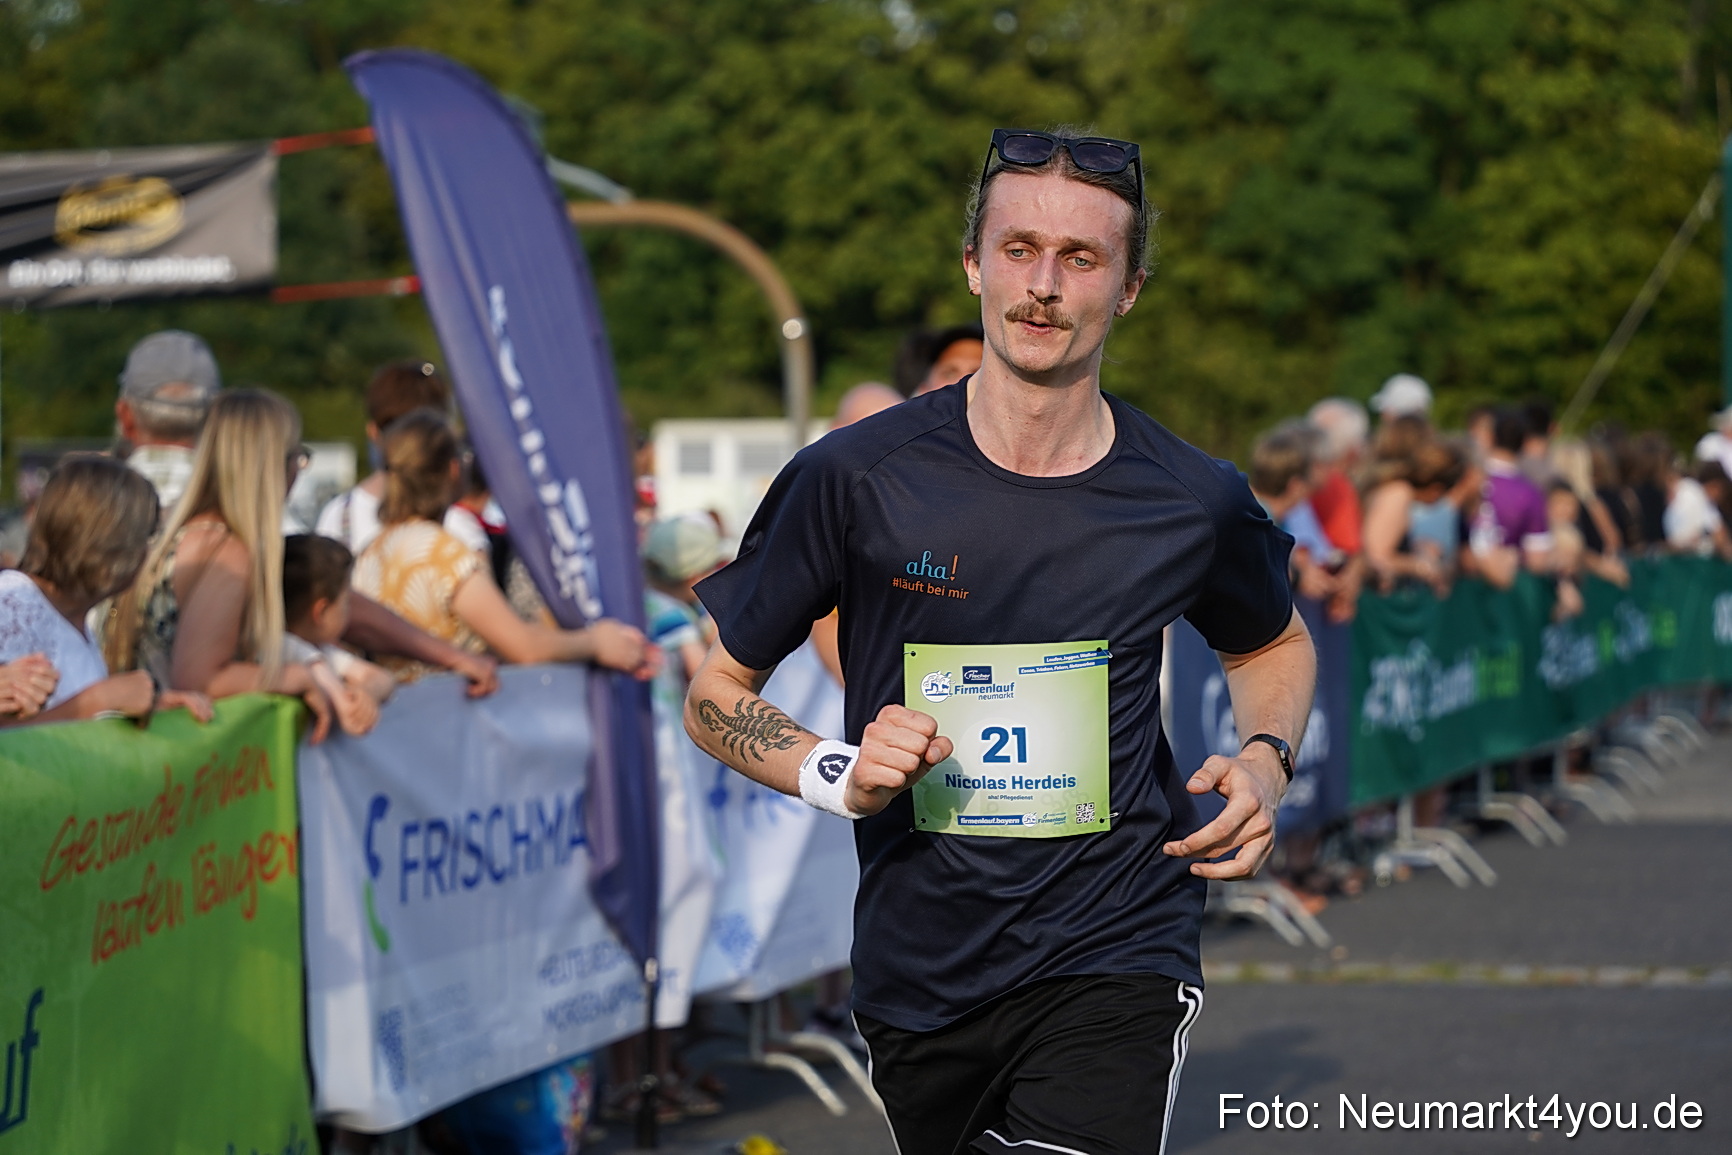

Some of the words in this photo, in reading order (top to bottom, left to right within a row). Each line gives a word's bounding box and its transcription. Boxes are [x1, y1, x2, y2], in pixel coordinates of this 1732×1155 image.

[906, 550, 959, 581] aha!
[892, 577, 925, 593] #läuft
[927, 583, 946, 597] bei
[948, 588, 970, 599] mir
[954, 682, 1015, 695] Firmenlauf
[978, 692, 1014, 701] neumarkt
[981, 726, 1027, 763] 21
[945, 773, 1007, 790] Nicolas
[1011, 773, 1077, 790] Herdeis
[40, 764, 184, 892] Gesunde
[960, 817, 1020, 826] firmenlauf.bayern
[92, 862, 187, 966] laufen
